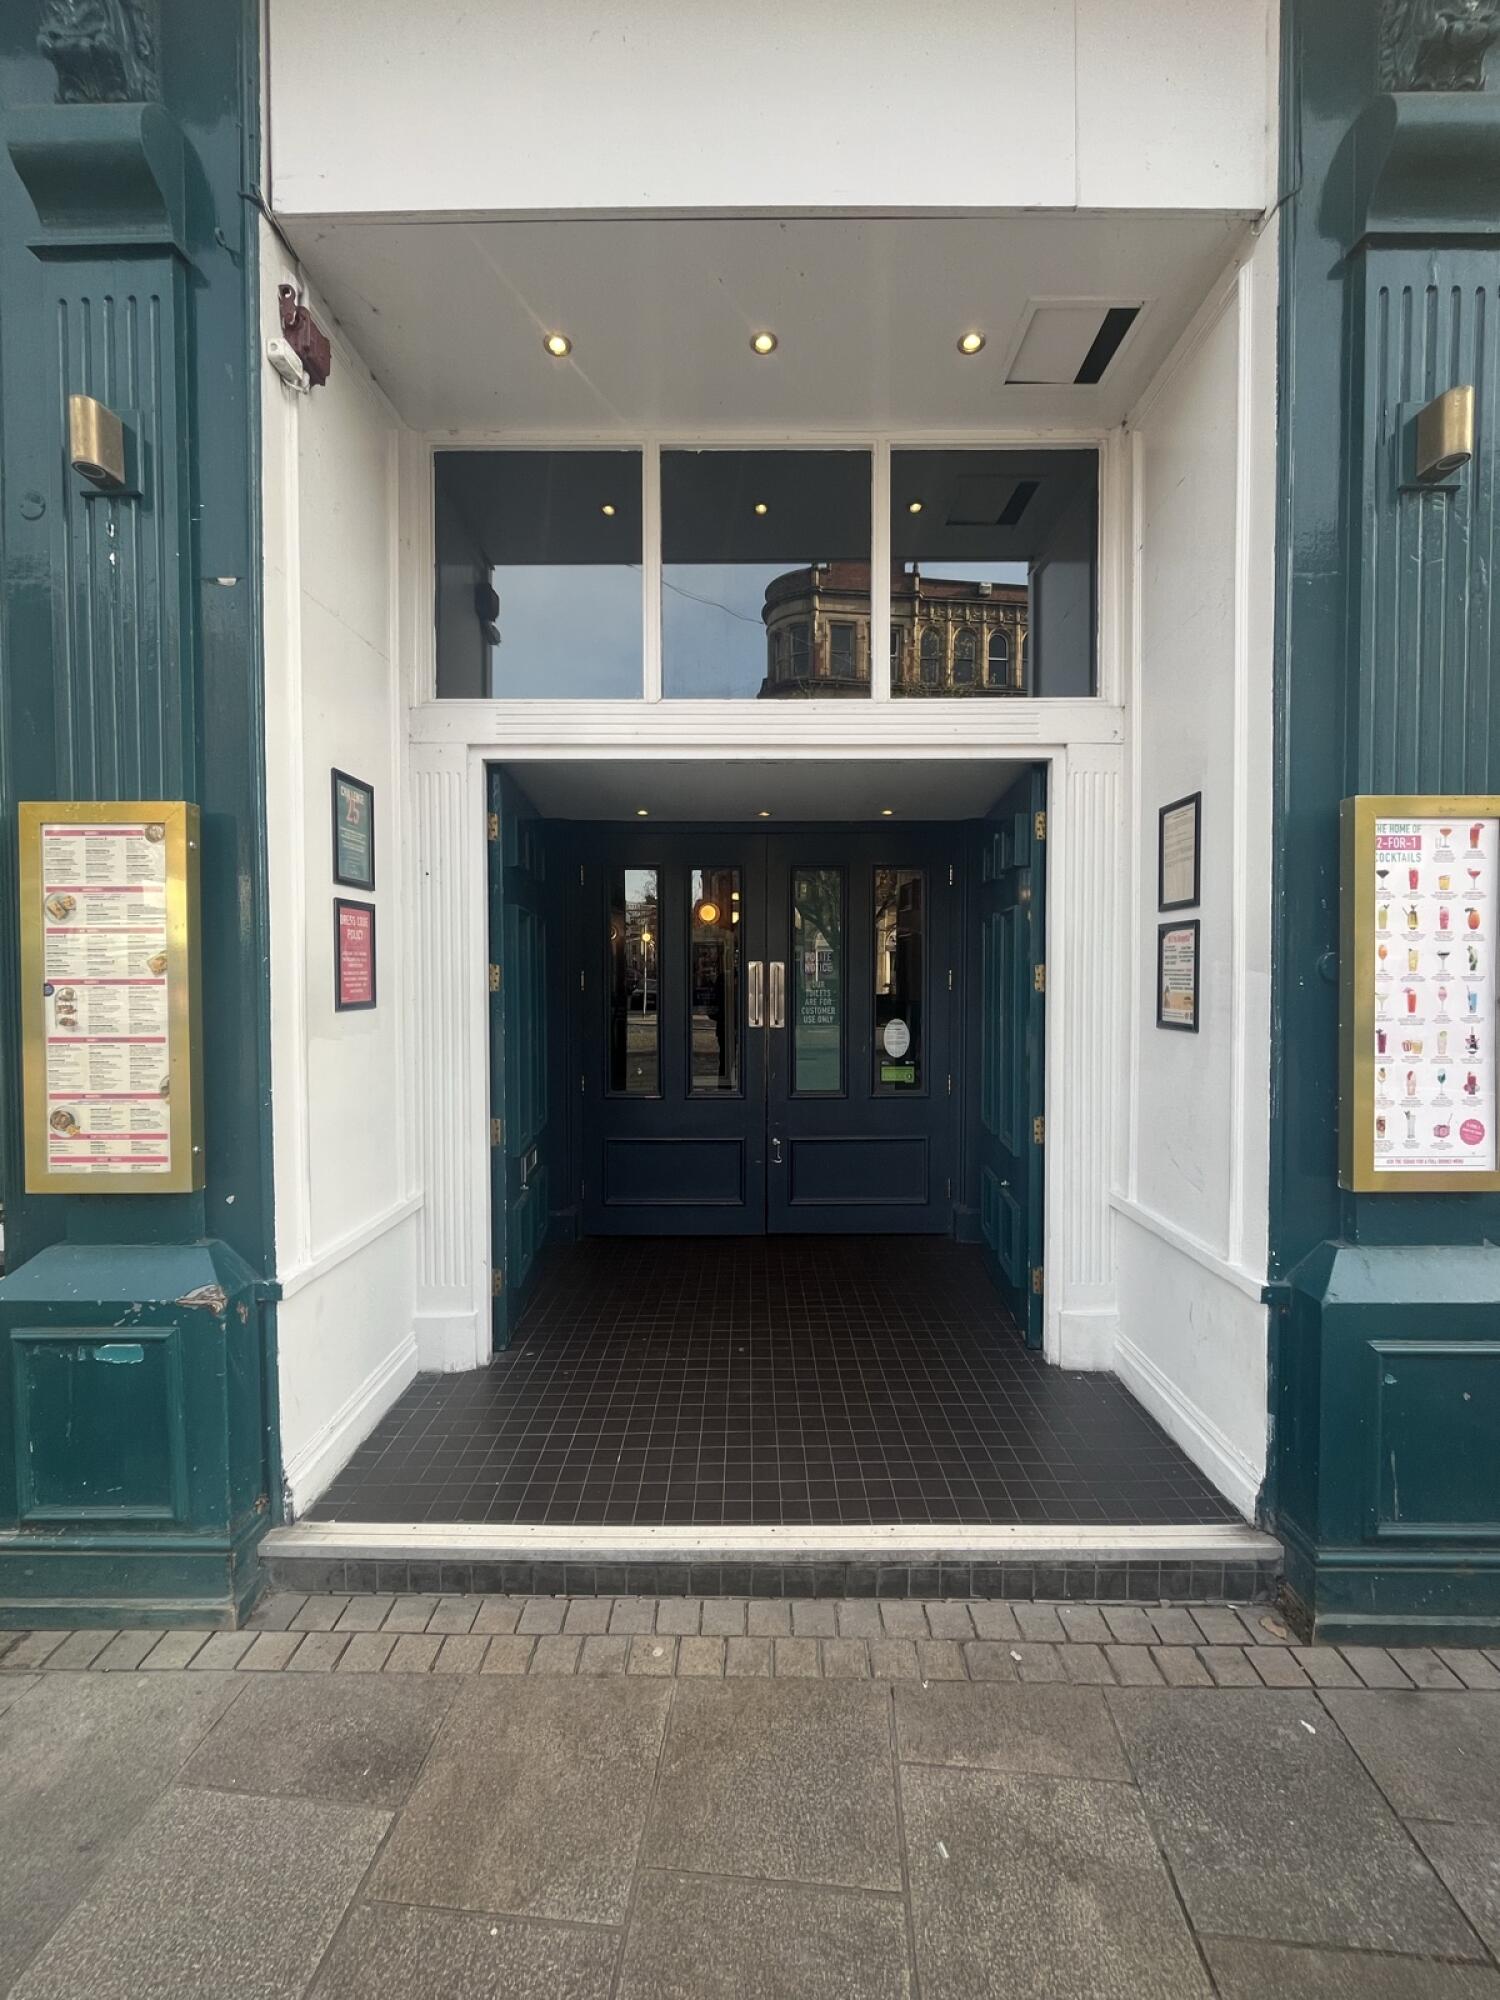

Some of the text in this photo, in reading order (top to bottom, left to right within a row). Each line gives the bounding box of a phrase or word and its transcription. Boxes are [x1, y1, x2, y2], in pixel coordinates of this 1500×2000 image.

[346, 799, 360, 825] 25
[1389, 824, 1411, 834] HOME
[1412, 824, 1422, 834] OF
[1376, 837, 1416, 849] 2-FOR-1
[804, 963, 833, 973] NOICE
[804, 998, 832, 1006] ARE FOR
[801, 1007, 836, 1015] CUSTOMER
[803, 1015, 834, 1024] USE ONLY
